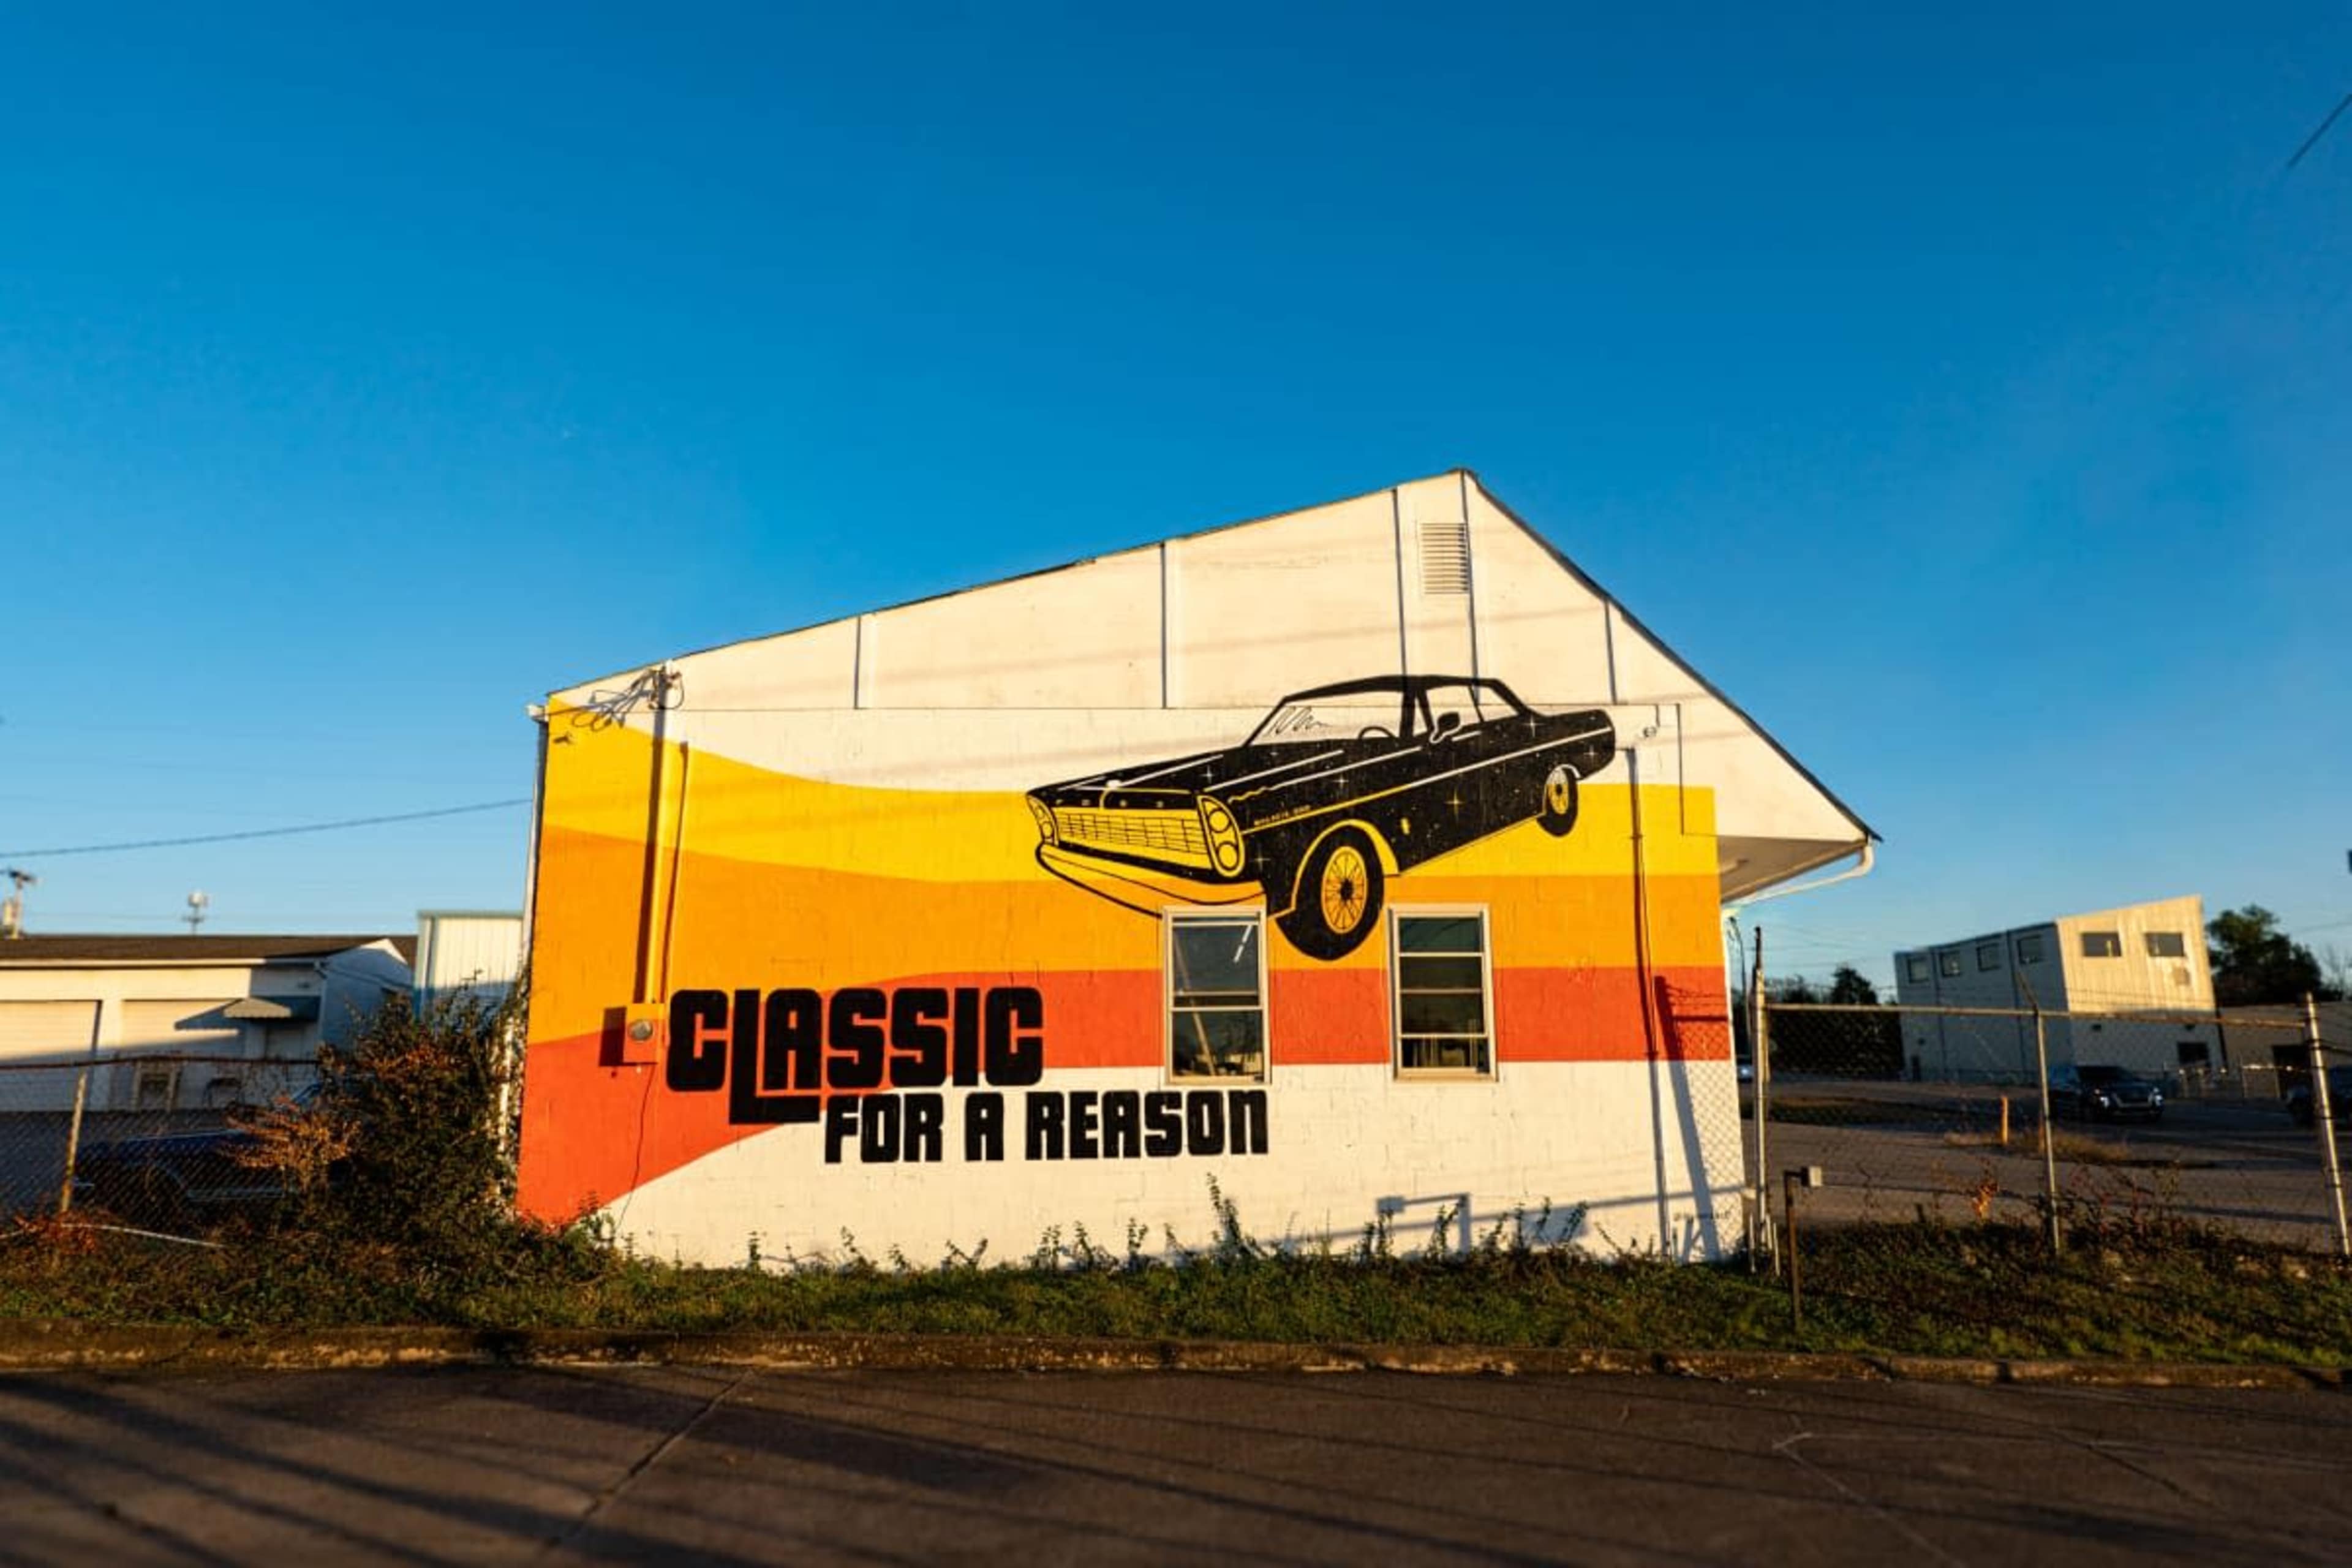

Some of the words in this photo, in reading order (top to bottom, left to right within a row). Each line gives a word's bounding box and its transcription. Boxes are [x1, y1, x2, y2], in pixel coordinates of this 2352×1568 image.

[666, 987, 1043, 1123] CLASSIC
[825, 1093, 943, 1163] FOR
[965, 1092, 1004, 1161] A
[1026, 1090, 1268, 1160] REASON
